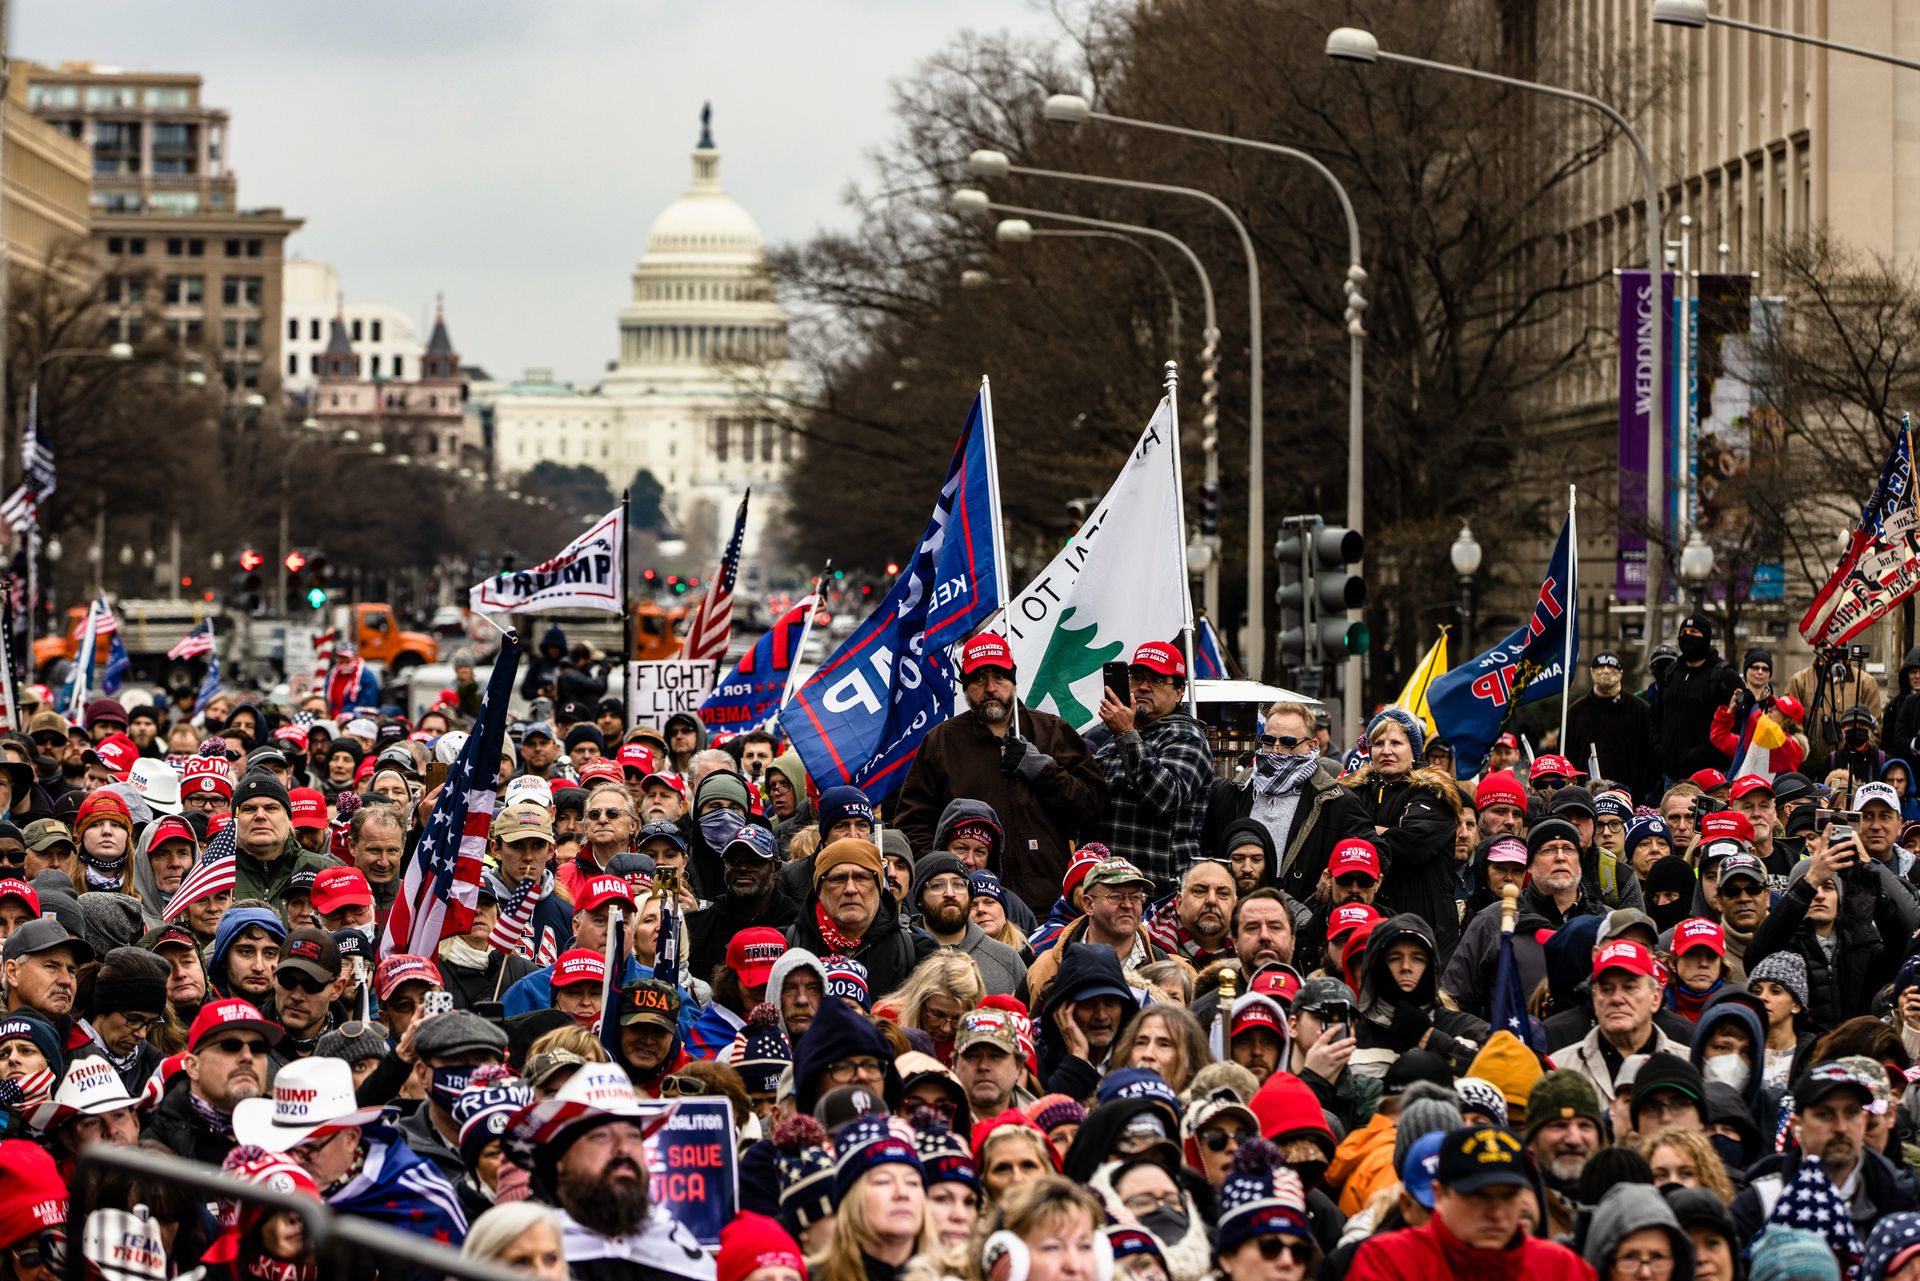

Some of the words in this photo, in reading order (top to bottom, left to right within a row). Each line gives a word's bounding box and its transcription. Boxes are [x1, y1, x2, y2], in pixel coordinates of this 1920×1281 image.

[1634, 284, 1652, 416] WEDDINGS
[495, 553, 611, 597] TRUMP
[968, 645, 982, 655] MAKE
[982, 643, 1004, 651] AMERICA
[971, 651, 987, 660] GREAT
[1147, 647, 1169, 659] AMERICA
[1149, 654, 1167, 664] AGAIN
[636, 664, 709, 691] FIGHT
[653, 690, 699, 713] LIKE
[187, 759, 229, 777] RUM
[131, 771, 148, 786] TEAM
[203, 780, 213, 788] 45
[1491, 792, 1517, 800] AMERICA
[1860, 784, 1893, 795] TRUMP
[1652, 823, 1660, 831] 45
[1340, 849, 1372, 858] TRUMP
[321, 879, 334, 888] KEEP
[335, 874, 358, 883] AMERICA
[624, 872, 653, 883] RUM
[0, 879, 32, 895] rump
[592, 879, 628, 897] MAGA
[974, 881, 1001, 893] UMP
[1684, 928, 1718, 937] TRUMP
[511, 921, 558, 967] SA
[744, 947, 785, 958] TRUMP
[562, 958, 580, 968] MAKE
[565, 964, 585, 974] GREAT
[585, 964, 604, 974] AGAIN
[826, 980, 864, 1002] 2020
[634, 990, 669, 1011] USA
[216, 1004, 237, 1017] MAKE
[0, 1022, 32, 1037] UMP
[68, 1064, 112, 1084] TRUMP
[763, 1075, 781, 1086] TRU
[77, 1073, 113, 1092] 2020
[275, 1087, 317, 1102] RUMP
[1117, 1081, 1176, 1099] TRUMP
[276, 1103, 308, 1115] 2020
[668, 1144, 724, 1168] SAVE
[273, 1179, 289, 1192] 45
